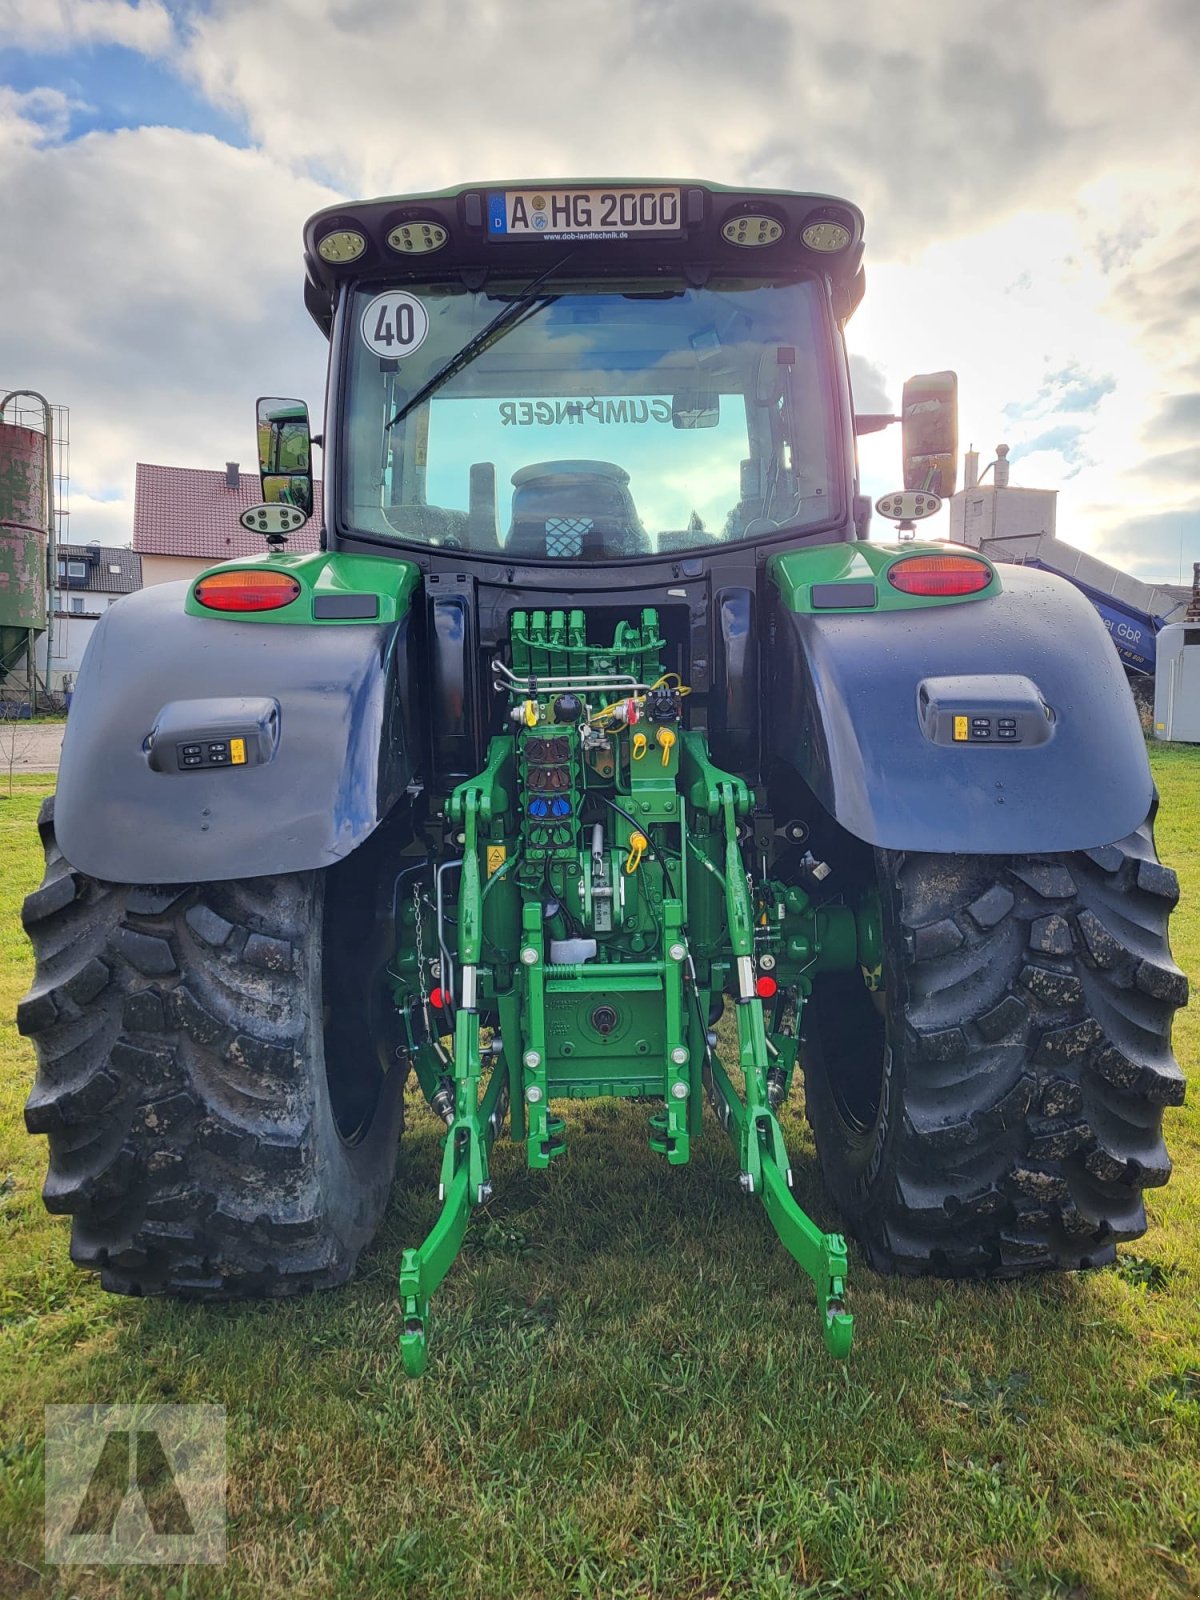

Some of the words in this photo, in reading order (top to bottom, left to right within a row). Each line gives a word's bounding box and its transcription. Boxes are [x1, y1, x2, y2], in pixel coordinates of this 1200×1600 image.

[510, 196, 529, 229] A
[551, 194, 592, 228] HG
[600, 192, 677, 226] 2000
[494, 218, 502, 227] D
[543, 231, 628, 240] www.dob-landtechnik.de
[374, 303, 415, 346] 40
[1117, 623, 1141, 643] GbR
